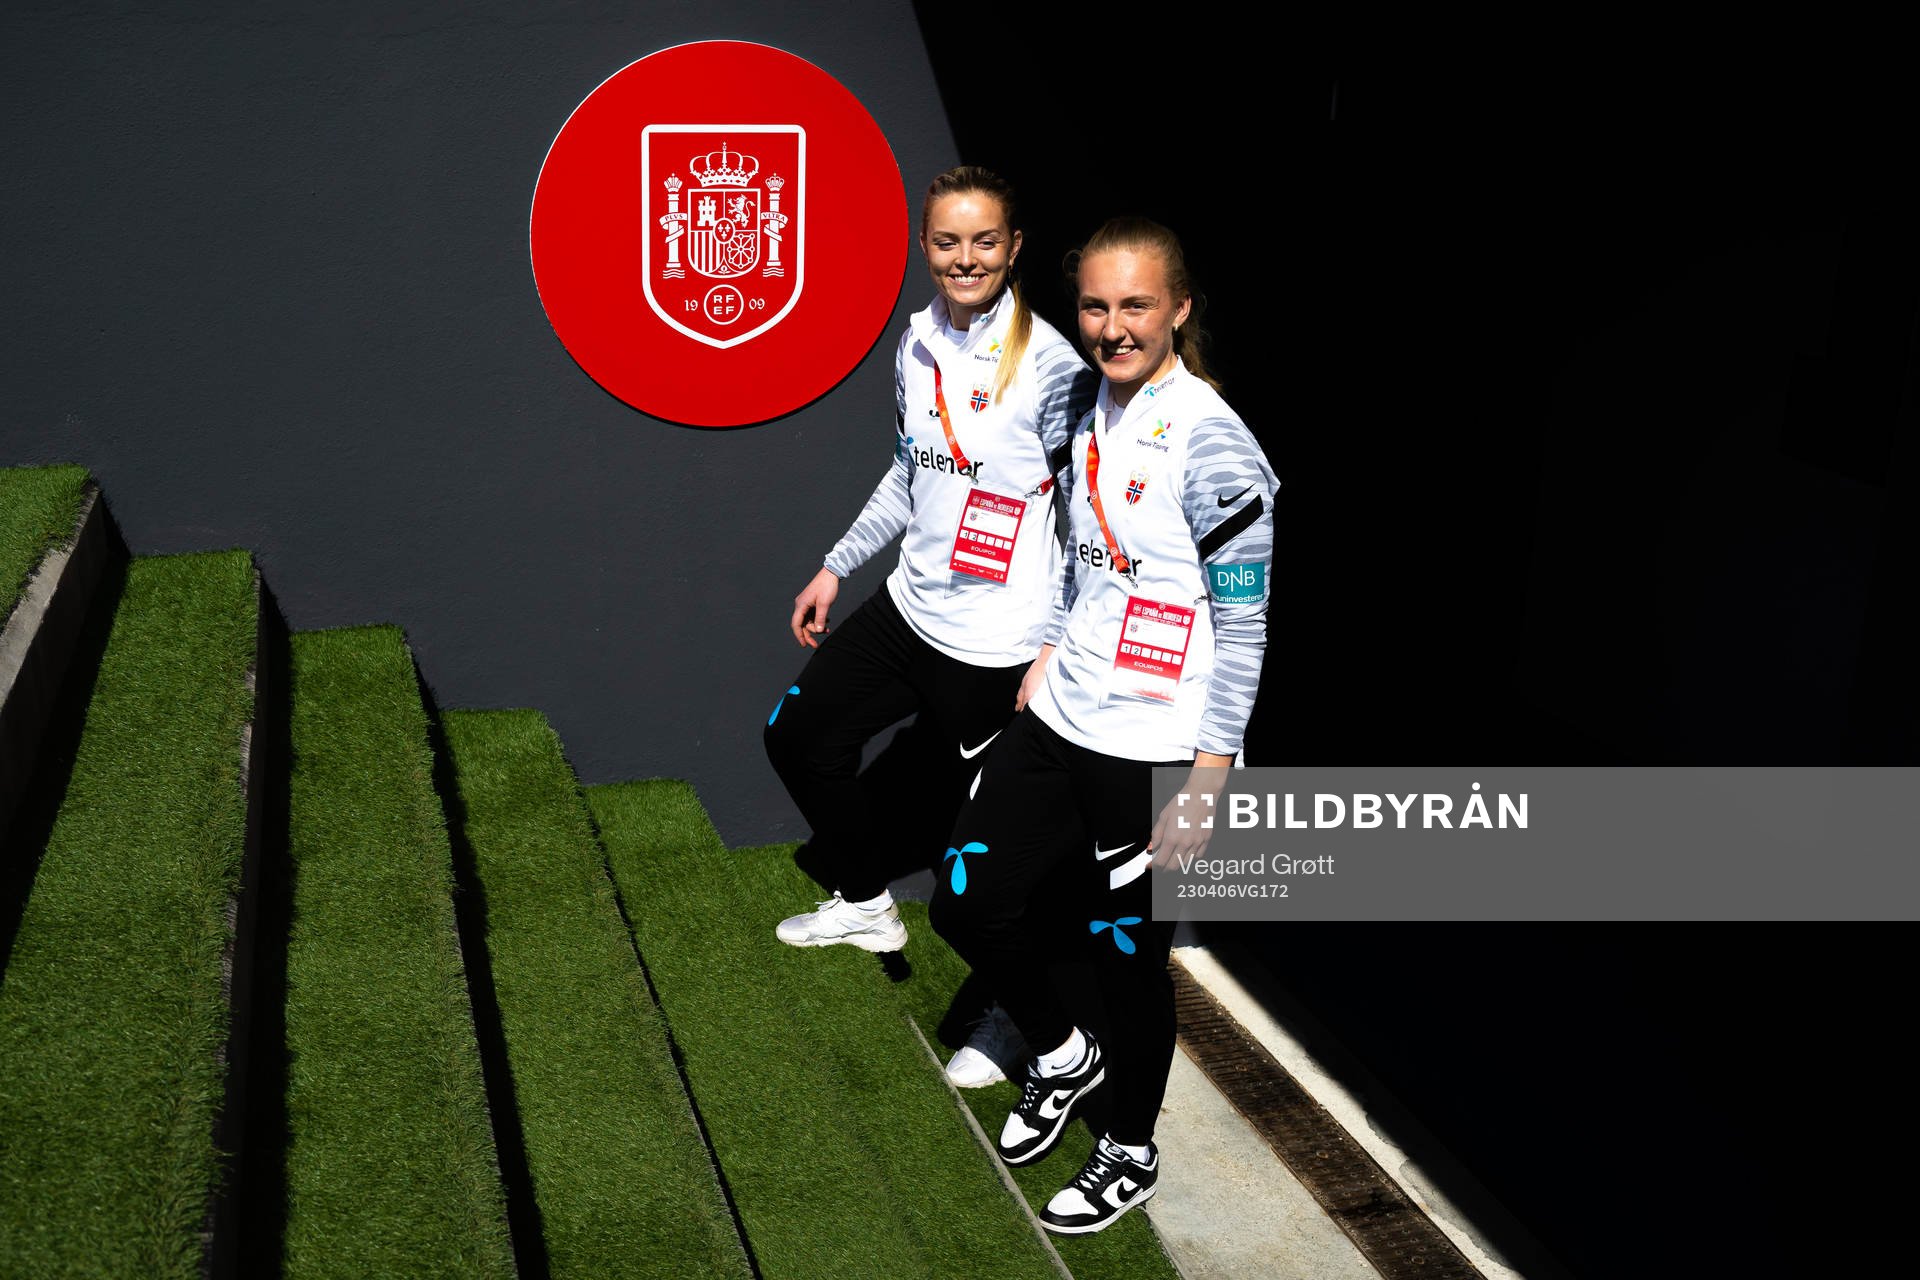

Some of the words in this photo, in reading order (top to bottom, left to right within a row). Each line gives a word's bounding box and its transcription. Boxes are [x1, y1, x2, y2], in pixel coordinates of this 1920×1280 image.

[684, 299, 698, 312] 19
[748, 298, 765, 310] 09
[970, 545, 997, 557] EQUIPOS
[1217, 565, 1256, 592] DNB
[1133, 661, 1164, 673] EQUIPOS
